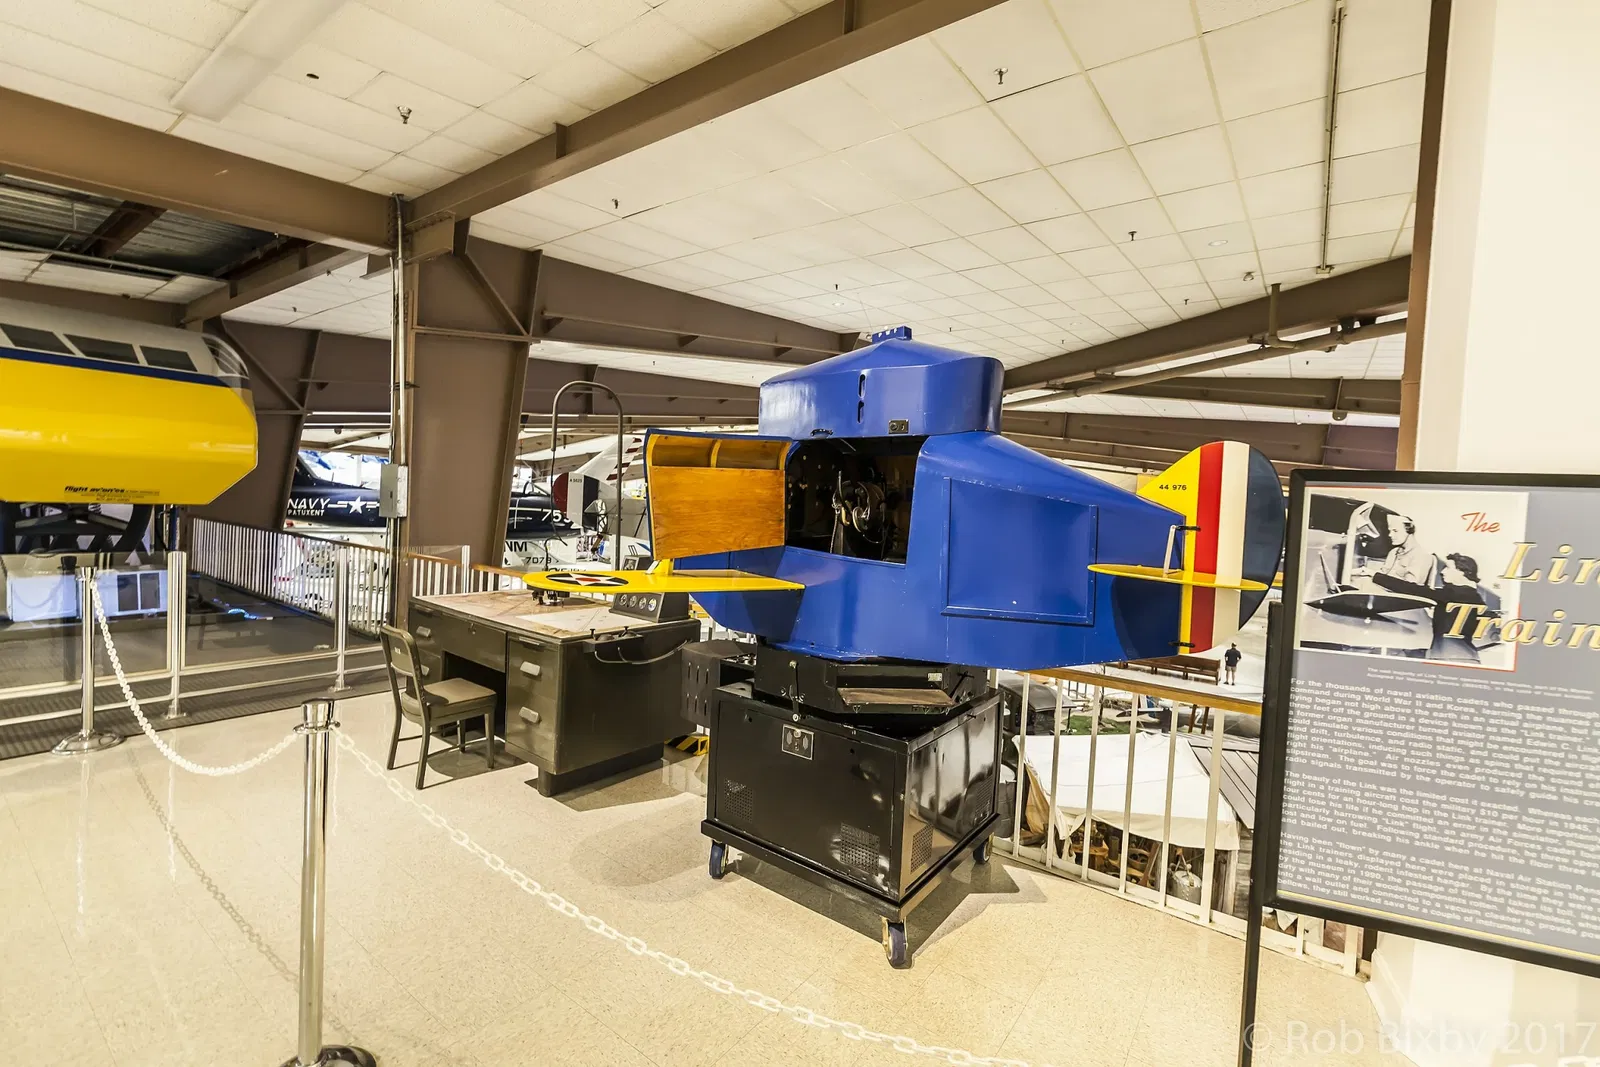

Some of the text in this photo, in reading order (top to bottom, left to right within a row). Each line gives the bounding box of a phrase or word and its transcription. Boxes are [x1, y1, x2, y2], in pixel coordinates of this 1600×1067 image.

[287, 498, 330, 509] NAVY
[1461, 512, 1500, 532] The
[1443, 602, 1600, 650] Train
[1290, 686, 1330, 695] command
[1333, 691, 1360, 700] during
[1364, 694, 1390, 702] World
[1325, 682, 1370, 692] thousands
[1290, 693, 1312, 702] flying
[1315, 696, 1341, 704] began
[1361, 702, 1380, 710] high
[1295, 709, 1324, 718] former
[1356, 718, 1414, 730] manufacturer
[1313, 721, 1348, 729] simulate
[1287, 731, 1308, 740] flight
[1368, 744, 1406, 754] inducing
[1311, 759, 1341, 768] signals
[1345, 764, 1396, 776] transmitted
[1284, 777, 1304, 786] flight
[1328, 785, 1360, 796] training
[1364, 792, 1395, 800] aircraft
[1302, 773, 1330, 783] beauty
[1359, 781, 1377, 789] Link
[1283, 794, 1305, 802] could
[1356, 797, 1398, 810] hour-long
[1401, 804, 1418, 813] hop
[1282, 801, 1329, 815] particularly
[1334, 809, 1377, 823] harrowing
[1300, 819, 1327, 829] bailed
[1352, 828, 1391, 842] breaking
[1377, 824, 1419, 838] Following
[1280, 831, 1308, 843] Having
[1312, 837, 1332, 846] been
[1368, 847, 1379, 855] by
[1382, 851, 1406, 860] many
[1297, 842, 1314, 850] Link
[1319, 847, 1352, 858] trainers
[1357, 854, 1400, 866] displayed
[1278, 854, 1288, 862] by
[1308, 861, 1344, 871] museum
[1279, 847, 1312, 859] residing
[1364, 864, 1392, 873] rodent
[1277, 869, 1293, 878] into
[1324, 880, 1349, 889] outlet
[1372, 889, 1418, 903] connected
[1278, 862, 1296, 871] dirty
[1317, 871, 1339, 880] many
[1353, 877, 1372, 885] their
[1375, 882, 1409, 892] wooden
[1313, 885, 1330, 894] they
[1350, 893, 1380, 904] worked
[1384, 900, 1404, 908] save
